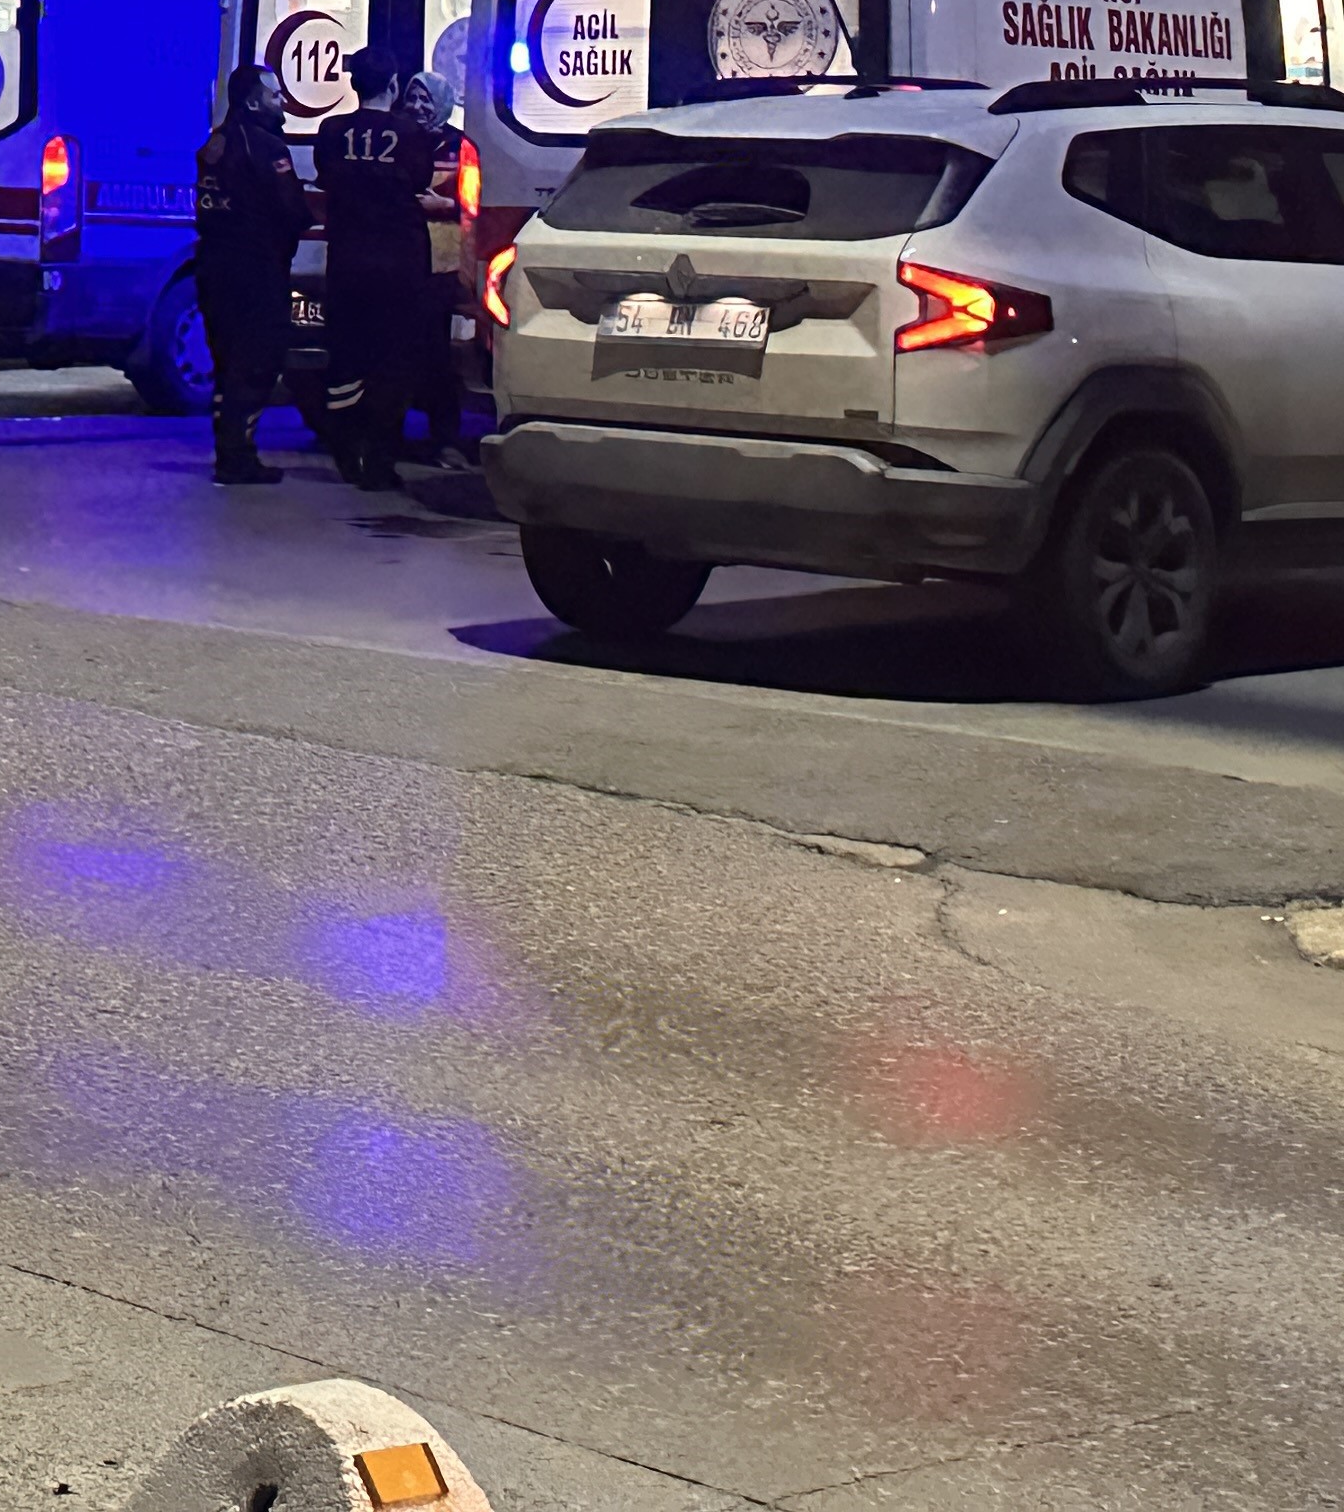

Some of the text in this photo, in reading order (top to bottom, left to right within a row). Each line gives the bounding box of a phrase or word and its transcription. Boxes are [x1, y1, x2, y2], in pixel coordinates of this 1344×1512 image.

[573, 9, 619, 40] ACİL
[1108, 8, 1232, 61] BAKANLIĞI
[291, 40, 340, 82] 112
[559, 46, 632, 76] SAĞLIK
[343, 128, 399, 163] 112
